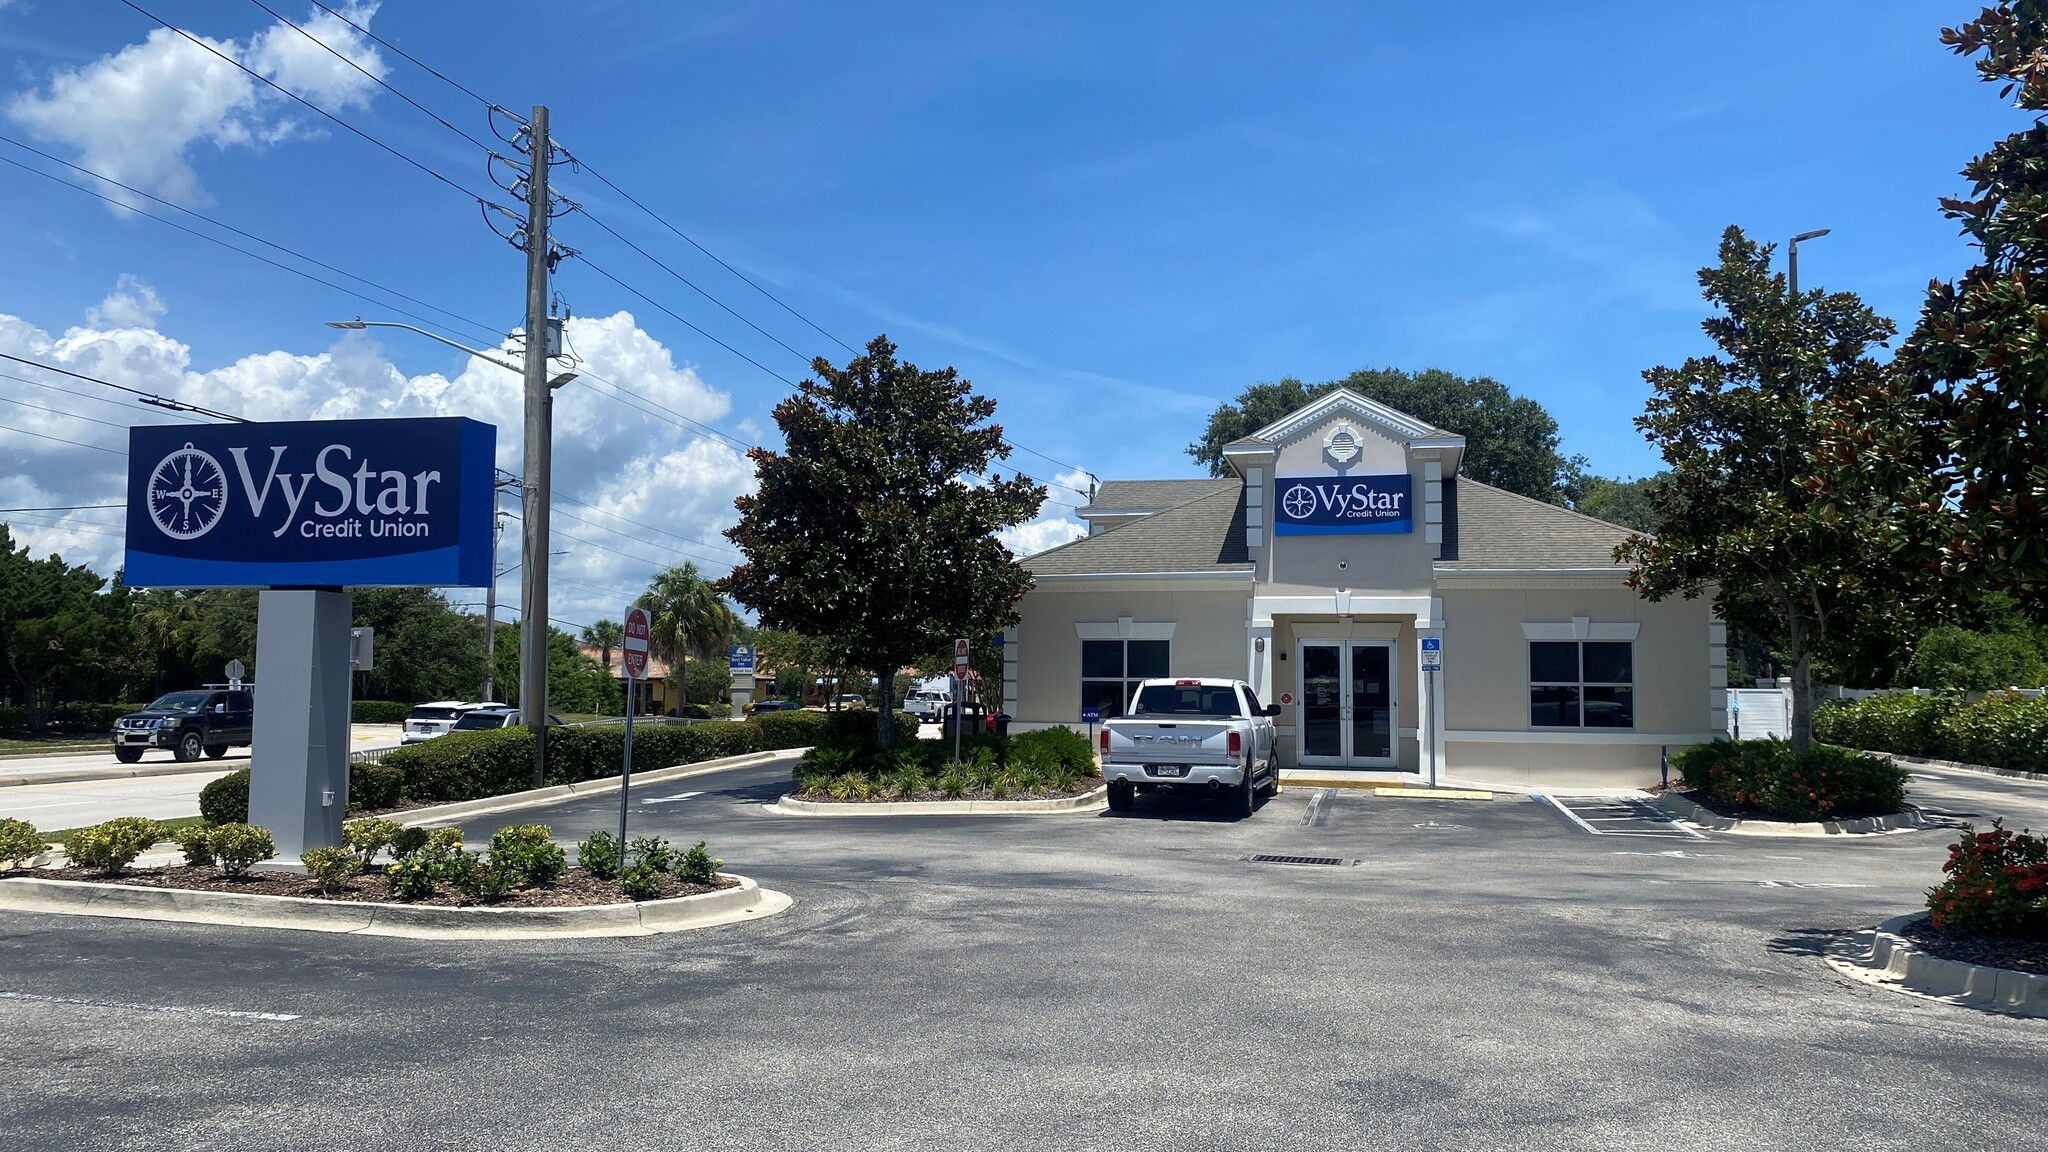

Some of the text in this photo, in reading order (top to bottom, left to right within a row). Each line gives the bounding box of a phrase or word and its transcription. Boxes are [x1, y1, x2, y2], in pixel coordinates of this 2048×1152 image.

[155, 489, 219, 500] W E
[228, 444, 441, 538] VyStar
[1316, 484, 1403, 518] VyStar
[1347, 509, 1400, 518] Credit Union
[300, 519, 429, 538] Credit Union
[628, 622, 646, 636] DO NOT
[628, 653, 643, 666] ENTER
[1133, 735, 1203, 748] RAM
